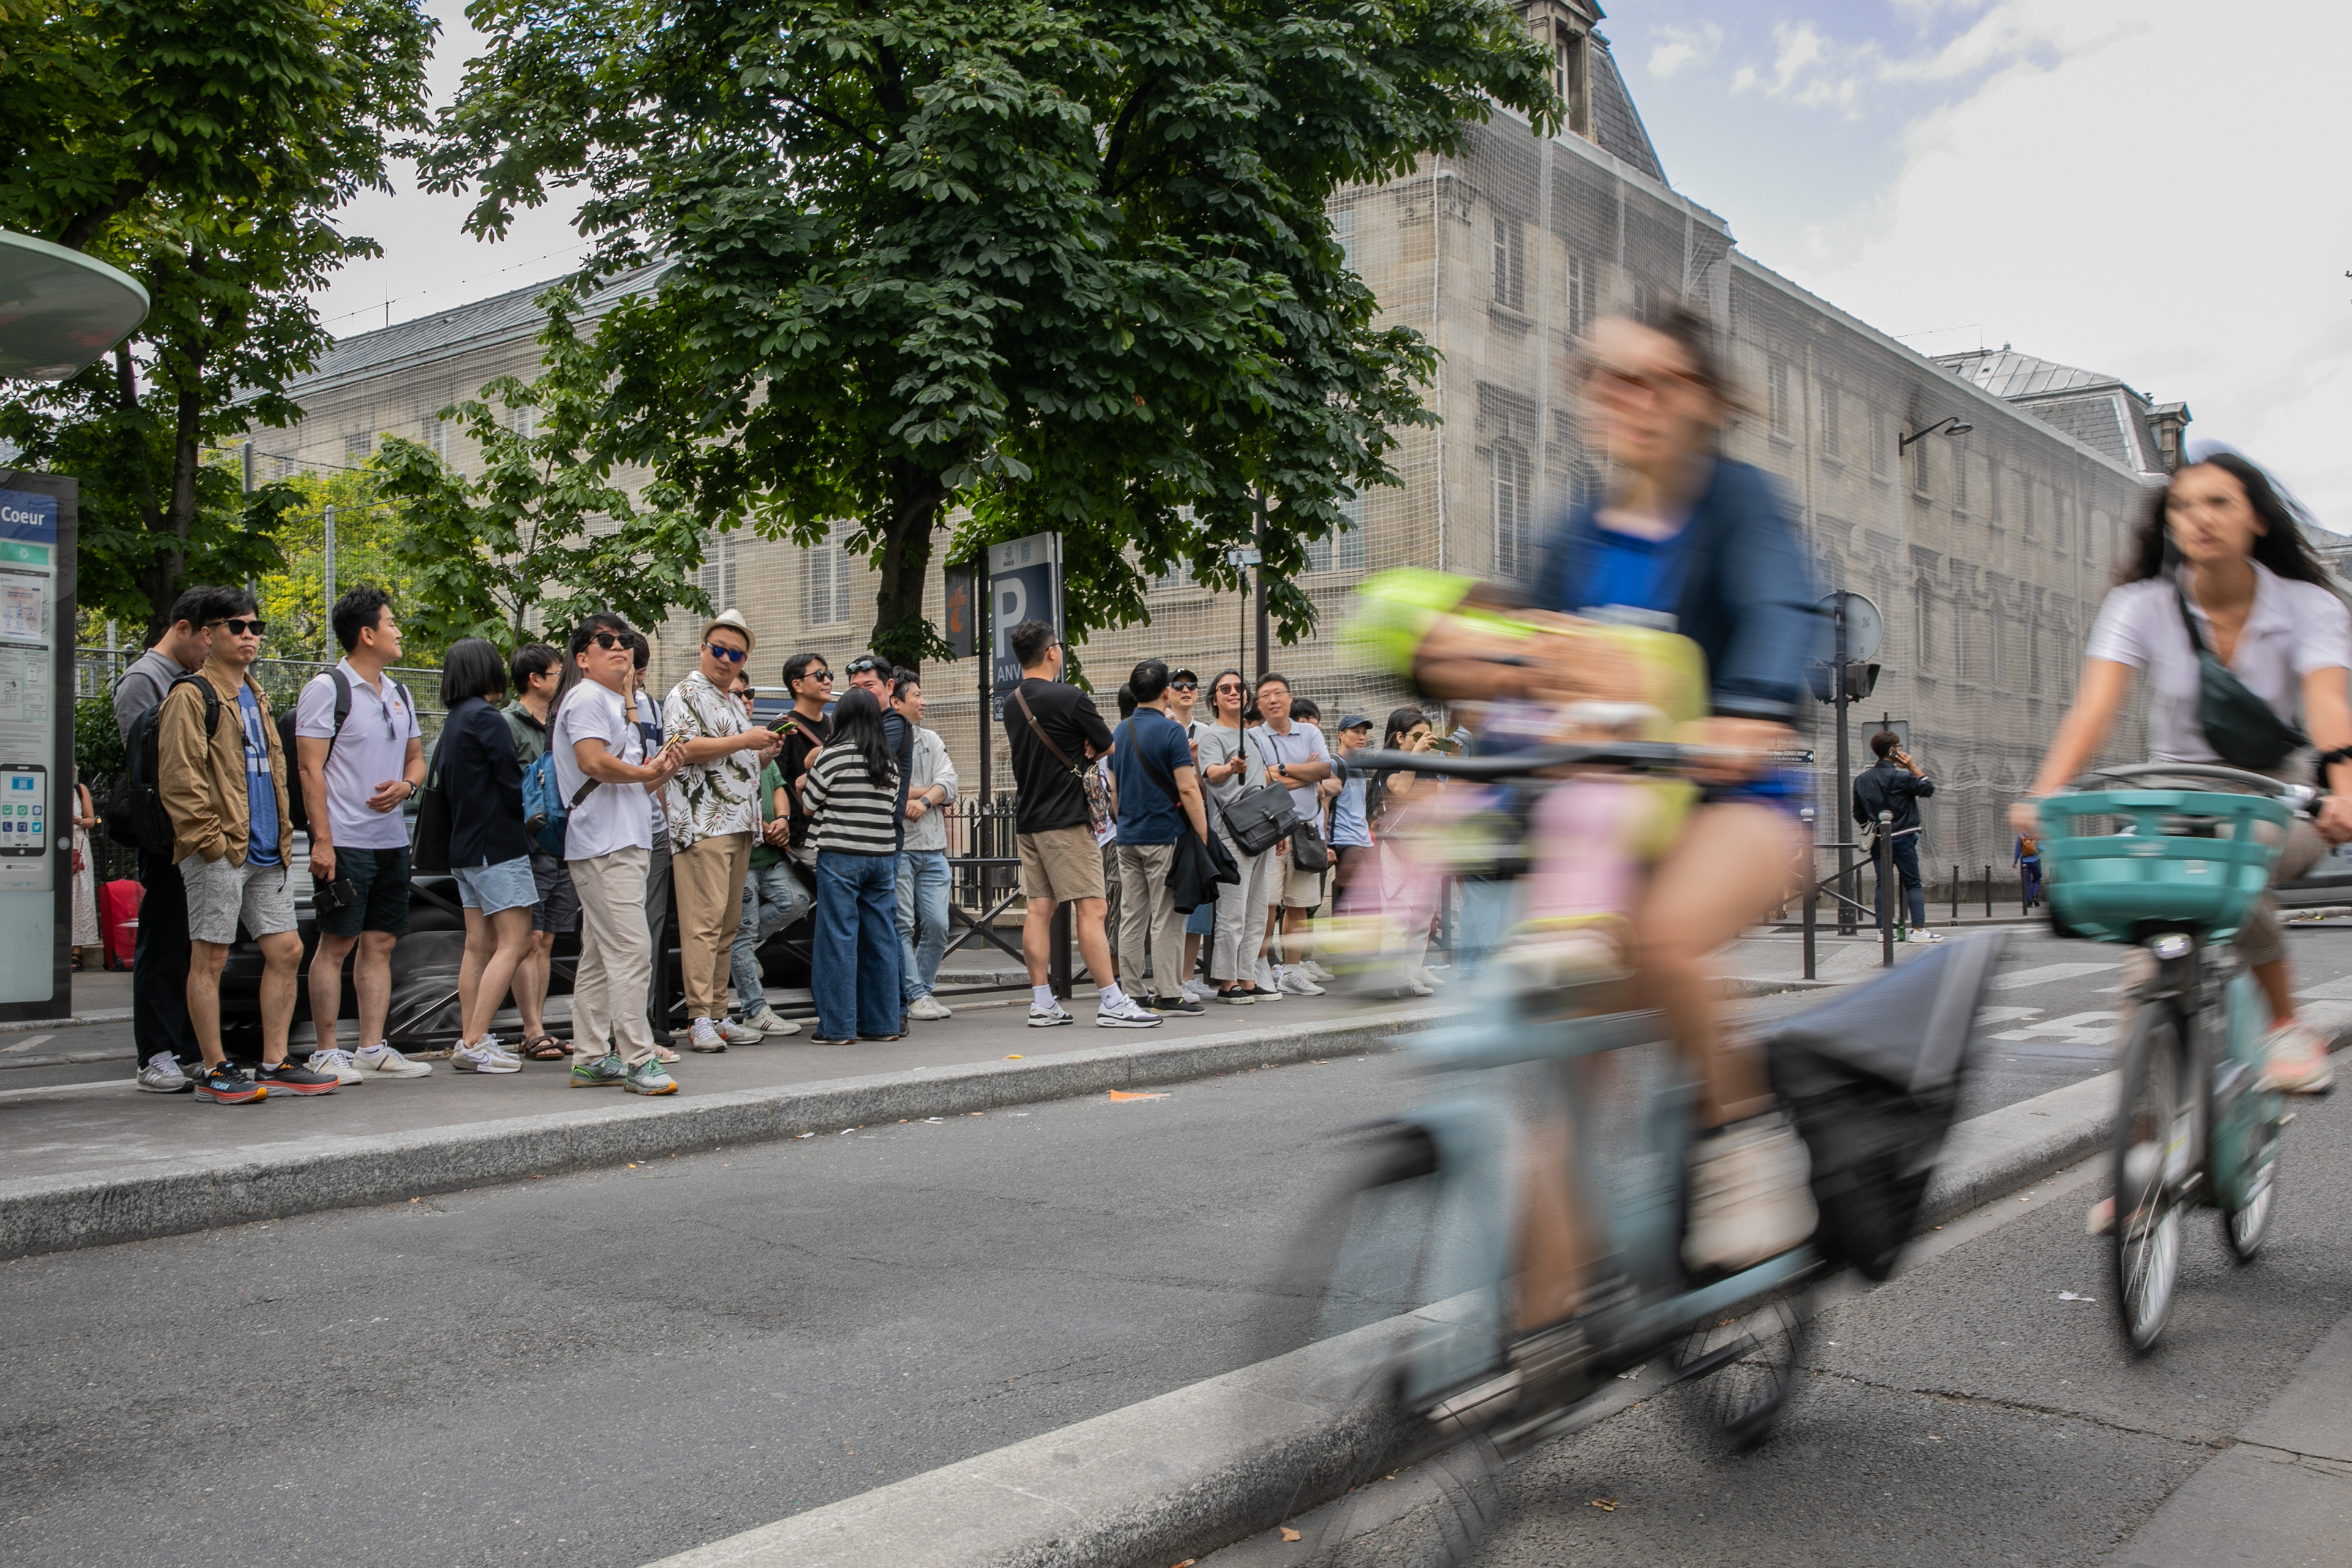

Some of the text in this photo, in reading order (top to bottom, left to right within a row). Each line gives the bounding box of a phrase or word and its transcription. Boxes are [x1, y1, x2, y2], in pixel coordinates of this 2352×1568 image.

[1, 506, 45, 526] Coeur
[994, 578, 1027, 659] P
[997, 663, 1023, 682] ANV
[210, 1080, 230, 1090] HOKA
